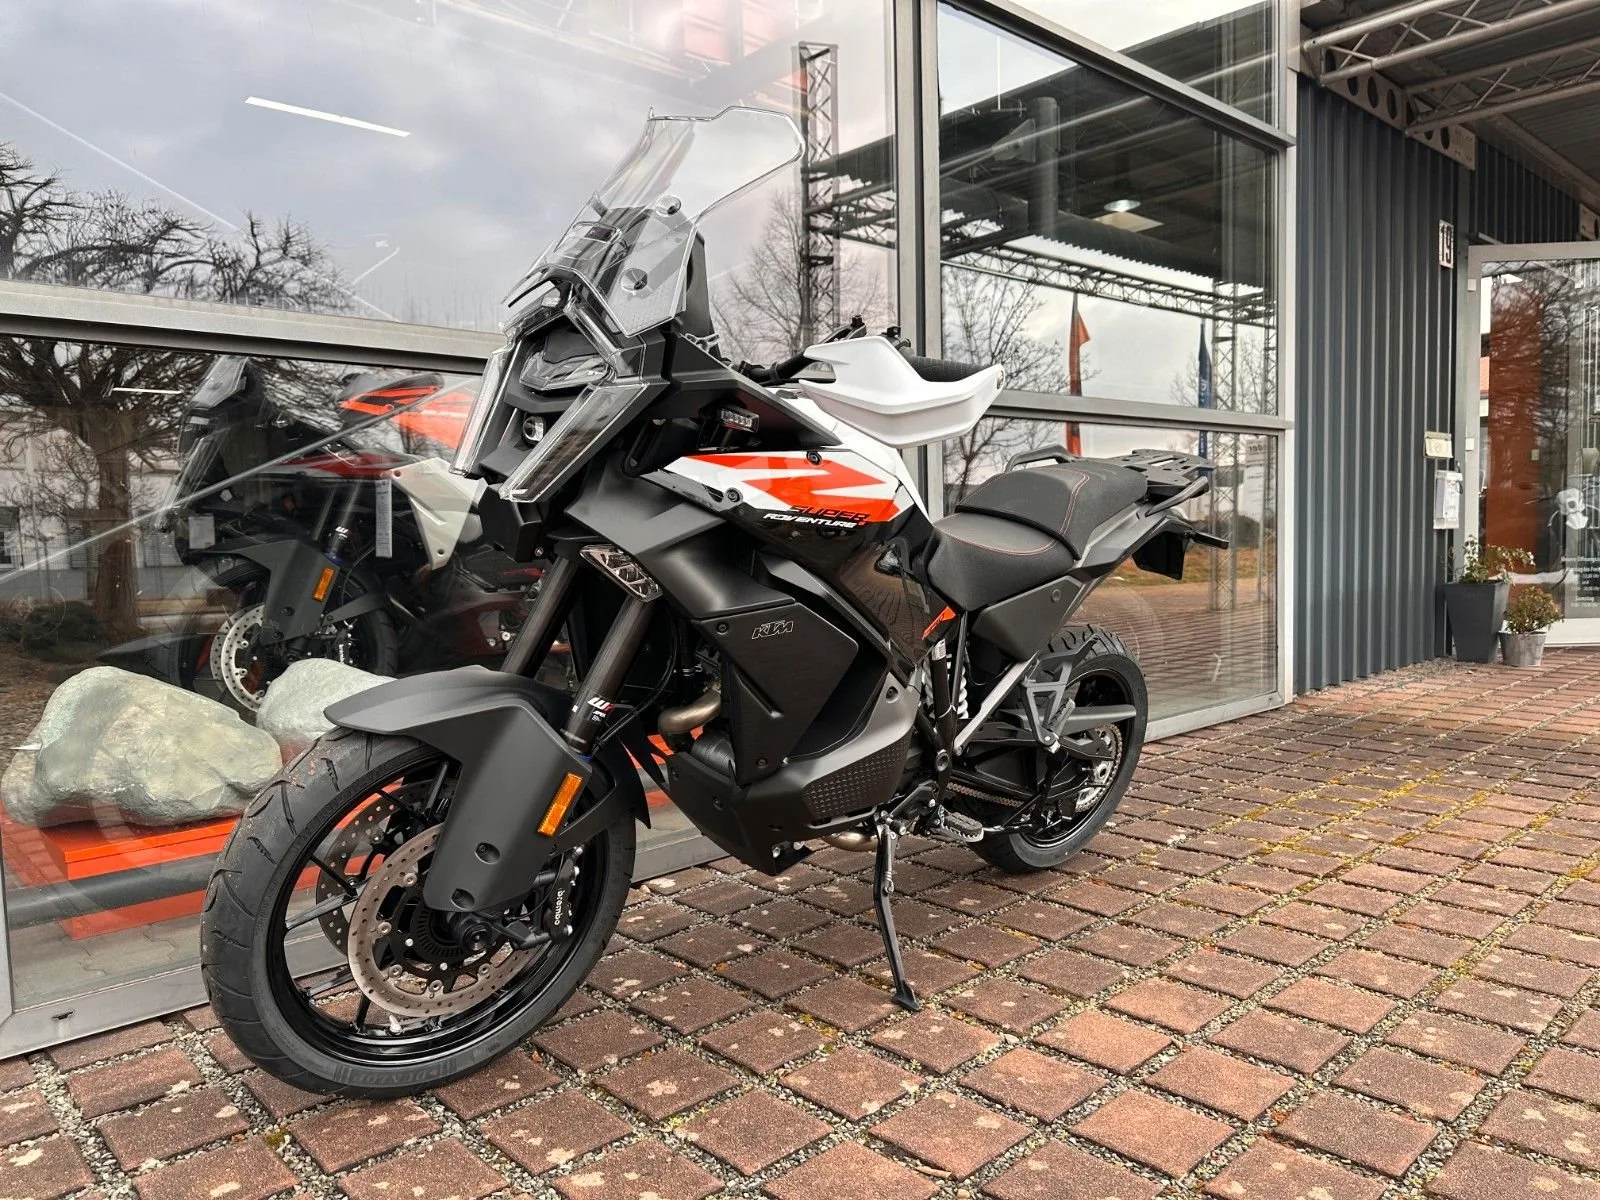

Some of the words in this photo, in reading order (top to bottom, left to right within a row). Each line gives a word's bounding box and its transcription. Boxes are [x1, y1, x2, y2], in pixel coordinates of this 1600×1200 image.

[1441, 224, 1452, 264] 19
[752, 620, 793, 639] KTM
[554, 889, 566, 926] brembo
